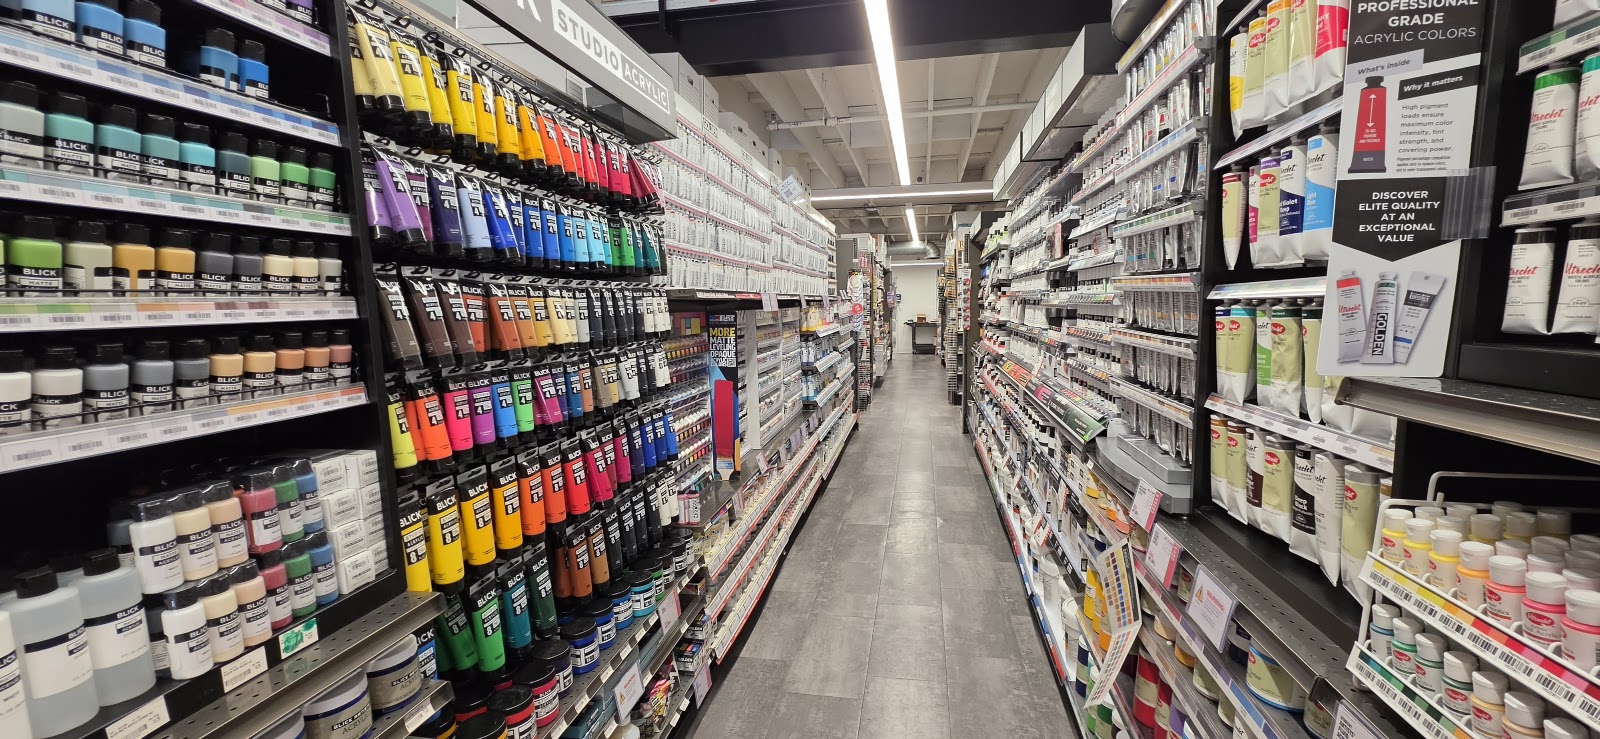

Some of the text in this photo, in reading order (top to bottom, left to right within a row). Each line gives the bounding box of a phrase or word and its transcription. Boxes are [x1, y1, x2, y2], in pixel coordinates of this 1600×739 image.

[1358, 0, 1478, 13] PROFESSIONAL
[36, 13, 69, 29] BLICK
[1388, 13, 1444, 27] GRADE
[1354, 27, 1477, 44] ACRYLIC COLORS
[557, 8, 668, 106] STUDIO ACRYLIC
[404, 63, 411, 74] 4
[1358, 59, 1410, 75] What's inside
[1404, 83, 1422, 92] Why
[1432, 75, 1463, 86] matters
[4, 134, 30, 143] BLICK
[55, 140, 87, 151] BLICK
[1372, 191, 1428, 200] DISCOVER
[444, 200, 450, 209] 4
[525, 198, 539, 206] BLICK
[1359, 201, 1440, 211] ELITE QUALITY
[1381, 213, 1415, 221] AT AN
[1359, 223, 1436, 232] EXCEPTIONAL
[1377, 234, 1414, 242] VALUE
[23, 268, 57, 276] BLICK
[1509, 266, 1541, 276] trecht
[1565, 262, 1600, 275] Utrech
[462, 286, 482, 294] BLICK
[1338, 304, 1361, 313] Utrecht
[396, 310, 402, 319] 4
[430, 312, 436, 320] 4
[709, 327, 735, 337] MORE
[1372, 313, 1388, 355] GOLDEN
[468, 379, 490, 387] BLICK
[492, 375, 509, 383] BLICK
[450, 382, 467, 390] BLICK
[100, 390, 127, 398] BLICK
[418, 387, 435, 396] BLICK
[477, 405, 483, 414] 4
[431, 416, 438, 425] 4
[401, 424, 407, 432] 4
[568, 450, 581, 460] BLICK
[548, 455, 562, 466] BLICK
[527, 464, 540, 475] BLICK
[500, 473, 517, 484] BLICK
[468, 482, 488, 497] BLICK
[436, 495, 457, 510] BLICK
[620, 501, 631, 511] BLICK
[1295, 501, 1307, 511] Black
[507, 504, 513, 513] 8
[400, 511, 422, 528] BLICK
[478, 518, 484, 527] 8
[605, 512, 617, 523] BLICK
[221, 520, 242, 530] BLICK
[443, 520, 458, 528] ACRYLIC
[590, 523, 602, 534] BLICK
[190, 529, 212, 541] BLICK
[445, 533, 452, 543] 8
[573, 533, 586, 544] BLICK
[155, 540, 177, 552] BLICK
[407, 536, 424, 546] ACRYLIC
[410, 552, 417, 563] 8
[532, 557, 548, 571] BLICK
[295, 573, 312, 584] BLICK
[507, 572, 524, 588] BLICK
[477, 588, 497, 607] BLICK
[540, 589, 546, 598] 8
[246, 599, 266, 610] BLICK
[117, 605, 139, 619] BLICK
[515, 606, 521, 615] 8
[452, 624, 459, 634] 8
[486, 626, 492, 636] 8
[332, 717, 352, 730] BLICK
